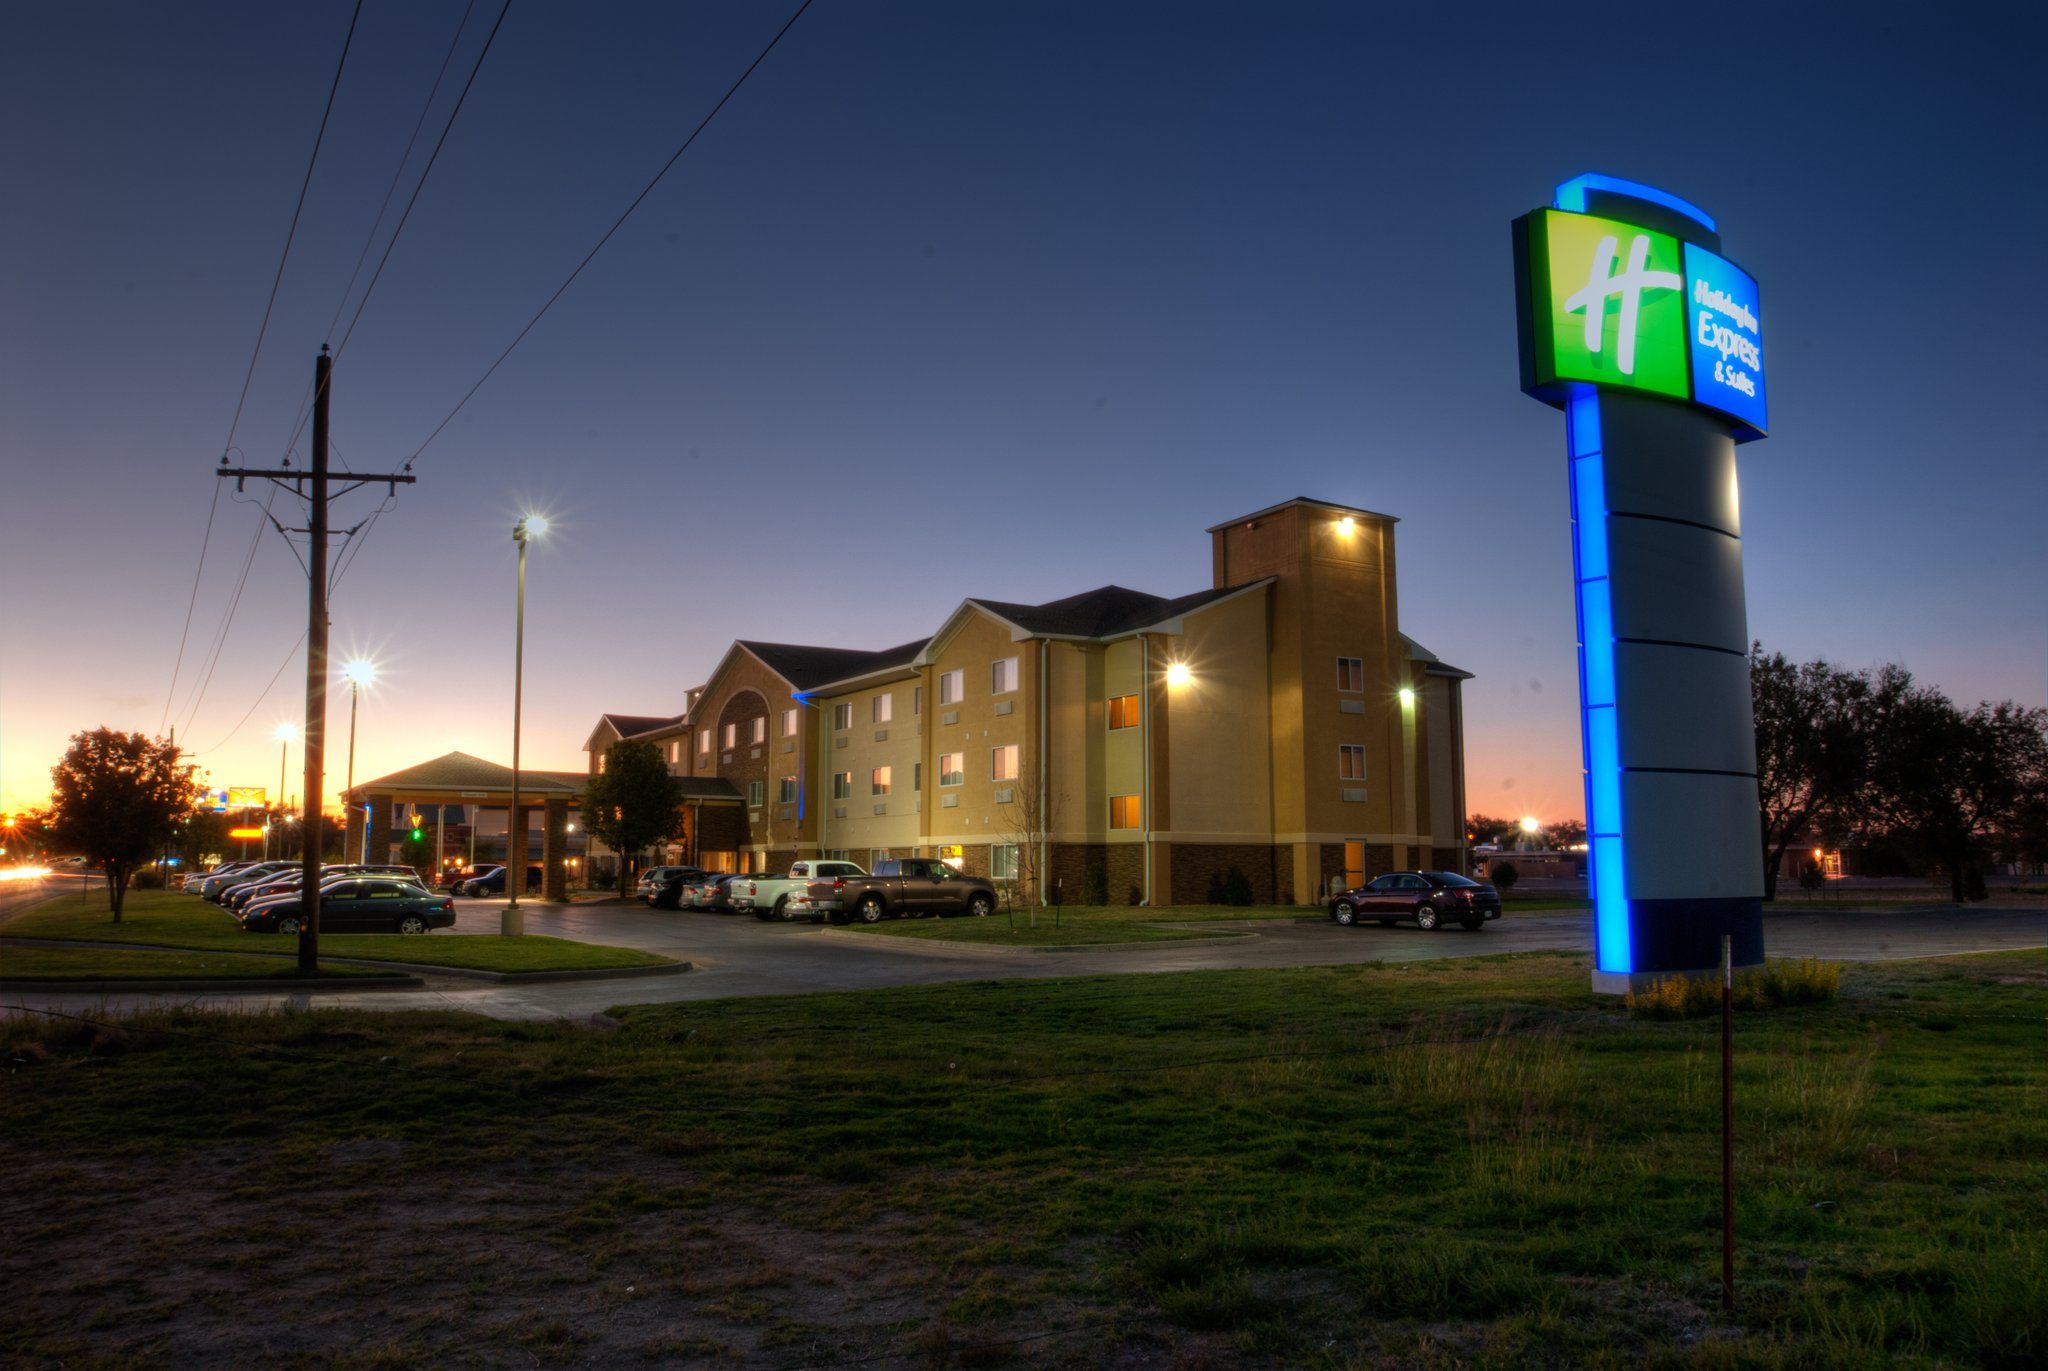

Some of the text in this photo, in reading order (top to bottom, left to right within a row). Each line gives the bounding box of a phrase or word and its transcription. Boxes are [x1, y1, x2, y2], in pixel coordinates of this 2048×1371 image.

[1698, 310, 1760, 372] Express
[1714, 360, 1755, 398] & Suites
